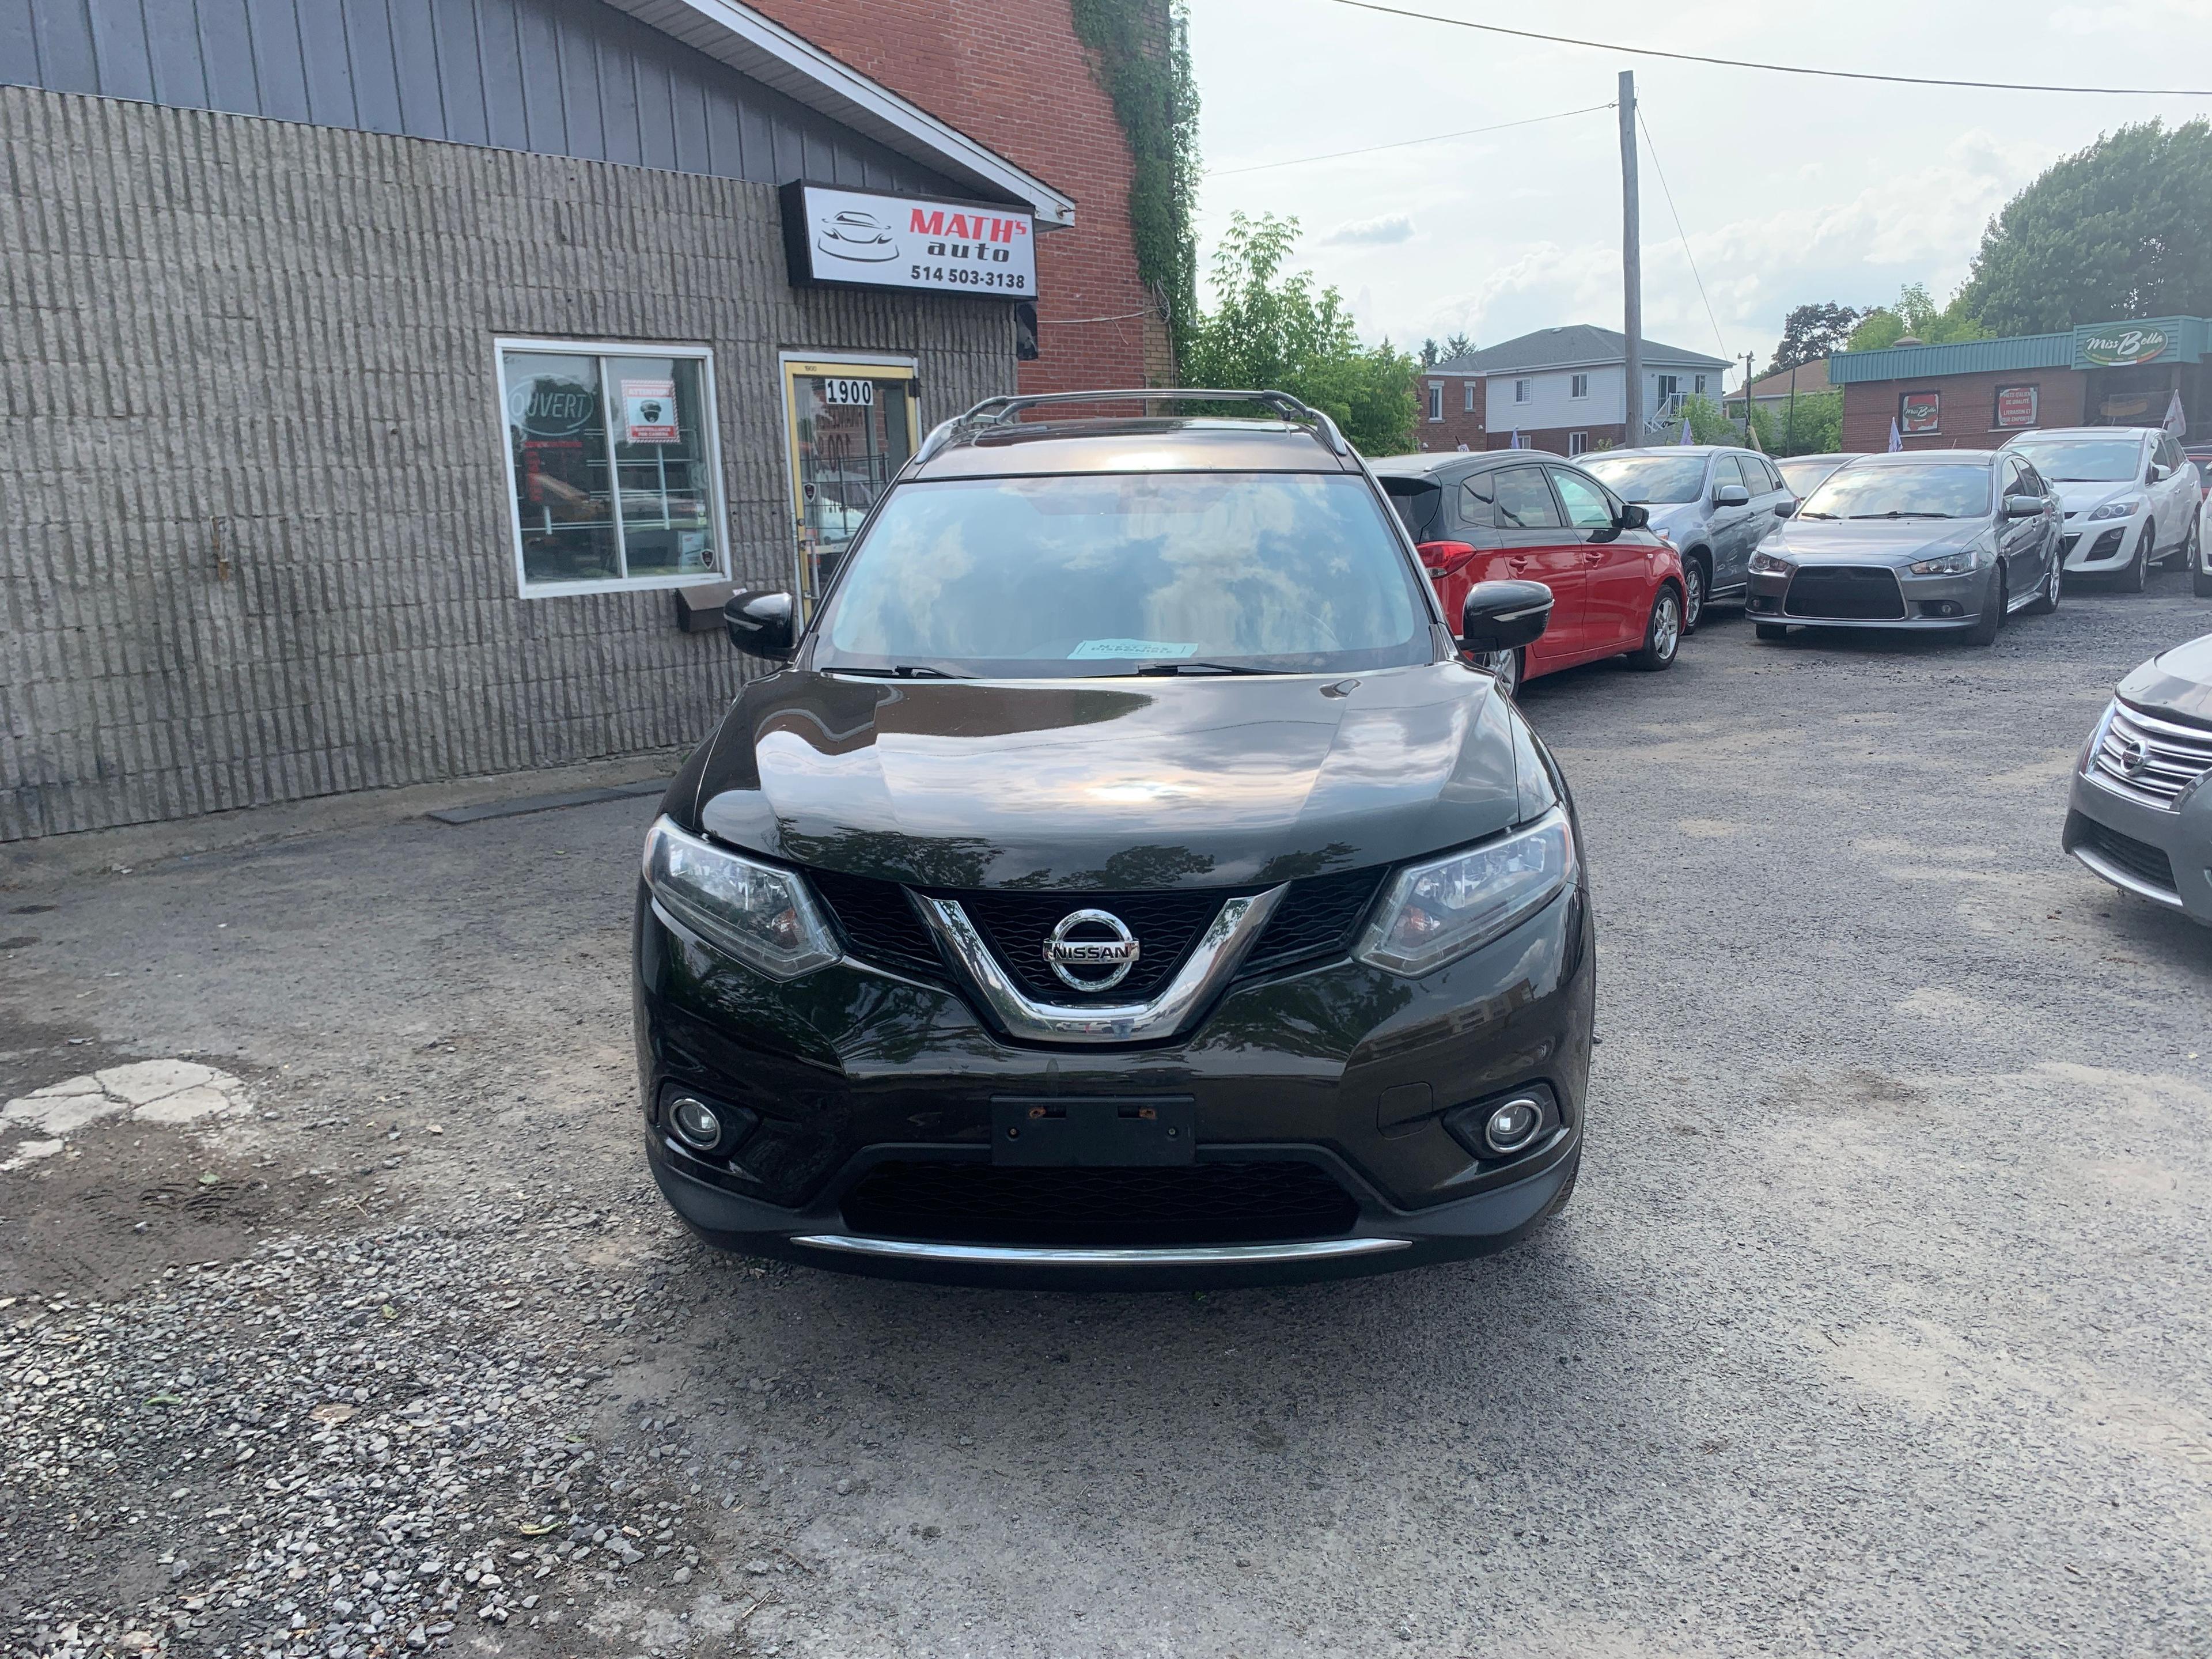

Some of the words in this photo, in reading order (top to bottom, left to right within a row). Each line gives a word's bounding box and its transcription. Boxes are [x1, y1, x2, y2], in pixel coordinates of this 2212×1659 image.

[927, 241, 1010, 263] auto
[910, 264, 944, 282] 514
[948, 268, 1025, 289] 503-3138
[2086, 337, 2120, 350] Miss
[2117, 331, 2164, 355] Bella
[827, 380, 871, 404] 1900
[510, 392, 587, 418] OUVERT
[1917, 406, 1936, 416] Bella
[1053, 946, 1129, 959] NISSAN
